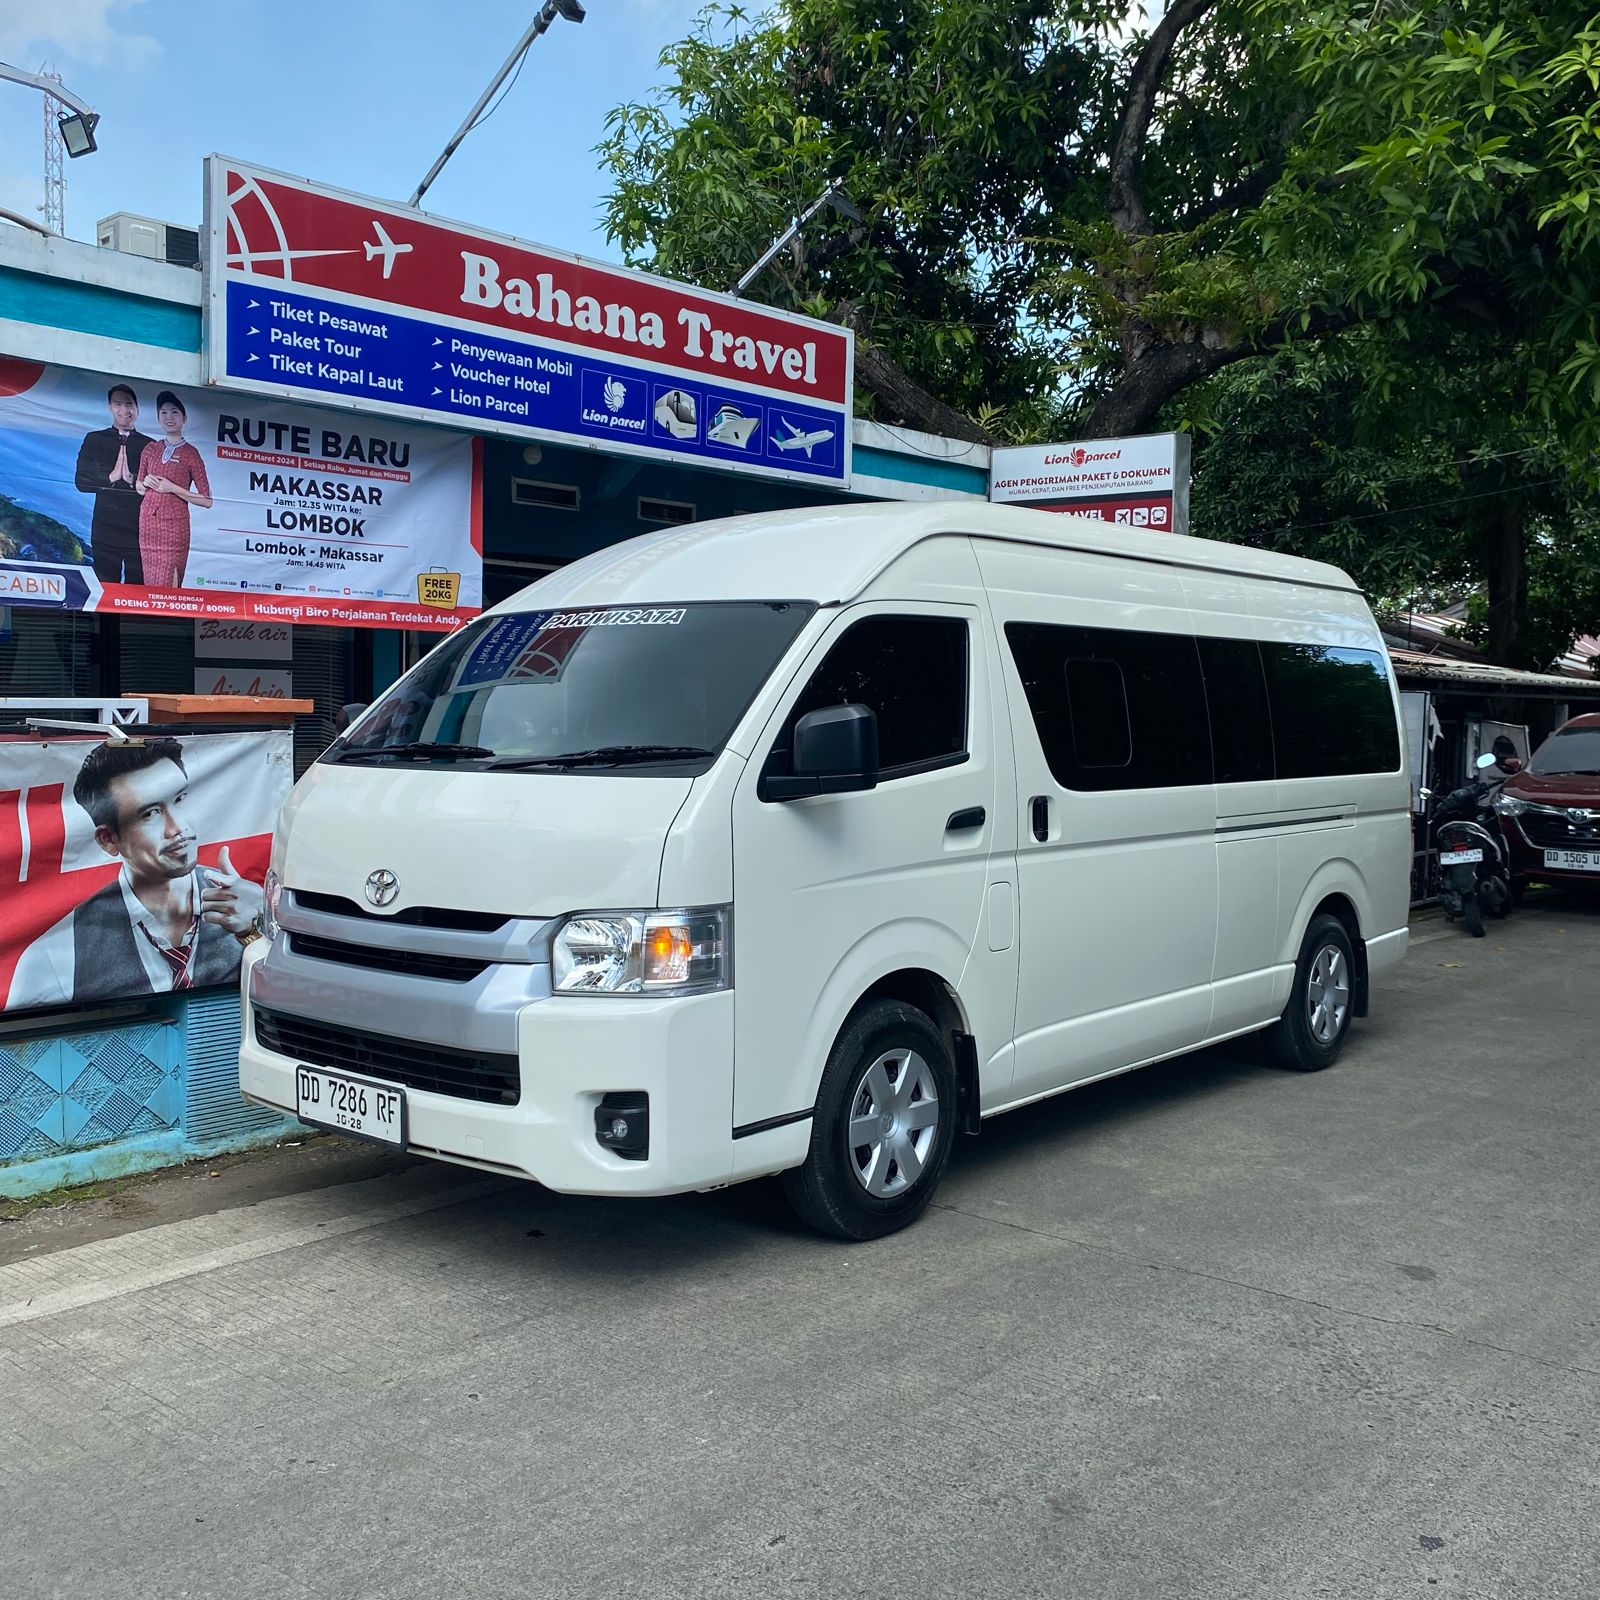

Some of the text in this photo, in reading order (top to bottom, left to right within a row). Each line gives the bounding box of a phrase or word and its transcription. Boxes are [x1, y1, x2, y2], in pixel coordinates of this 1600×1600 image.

[270, 301, 388, 338] Tiket Pesawat
[460, 251, 817, 384] Bahana Travel
[271, 328, 361, 358] Paket Tour
[451, 339, 573, 377] Penyewaan Mobil
[269, 354, 403, 391] Tiket Kapal Laut
[450, 362, 550, 395] Voucher Hotel
[451, 389, 529, 415] Lion Parcel
[583, 409, 646, 430] Lion parcel
[218, 414, 410, 468] RUTE BARU
[222, 449, 242, 458] Mulai
[254, 453, 276, 463] Maret
[276, 457, 296, 465] 2024
[1044, 449, 1121, 465] Lion parcel
[303, 460, 326, 470] Setiap
[327, 463, 347, 474] Rabu,
[348, 467, 368, 476] Jumat
[383, 472, 408, 481] Minggu
[994, 467, 1171, 489] AGEN PENGIRIMAN PAKET & DOKUMEN
[249, 471, 383, 506] MAKASSAR
[1008, 488, 1031, 496] MURAH,
[1031, 486, 1051, 494] CEPAT,
[1051, 484, 1065, 492] DAN
[1081, 481, 1126, 490] PENJEMPUTAN
[1126, 479, 1153, 487] BARANG
[273, 497, 362, 515] Jam: 12.35 WITA ke:
[266, 508, 367, 538] LOMBOK
[245, 538, 306, 557] Lombok
[319, 547, 384, 564] Makassar
[286, 558, 346, 571] Jam: 14.45 WITA
[424, 578, 452, 589] FREE
[425, 589, 452, 599] 20KG
[114, 598, 149, 609] BOEING
[151, 601, 198, 611] 737-900ER
[206, 605, 236, 614] 800NG
[148, 593, 177, 601] TERBANG
[254, 604, 460, 625] Hubungi Biro Perjalanan Terdekat Anda
[538, 608, 687, 630] PARIWISATA
[200, 619, 289, 641] Batik air
[1546, 851, 1559, 861] DD
[1563, 852, 1588, 864] 1505
[300, 1073, 397, 1123] DD 7286 RF
